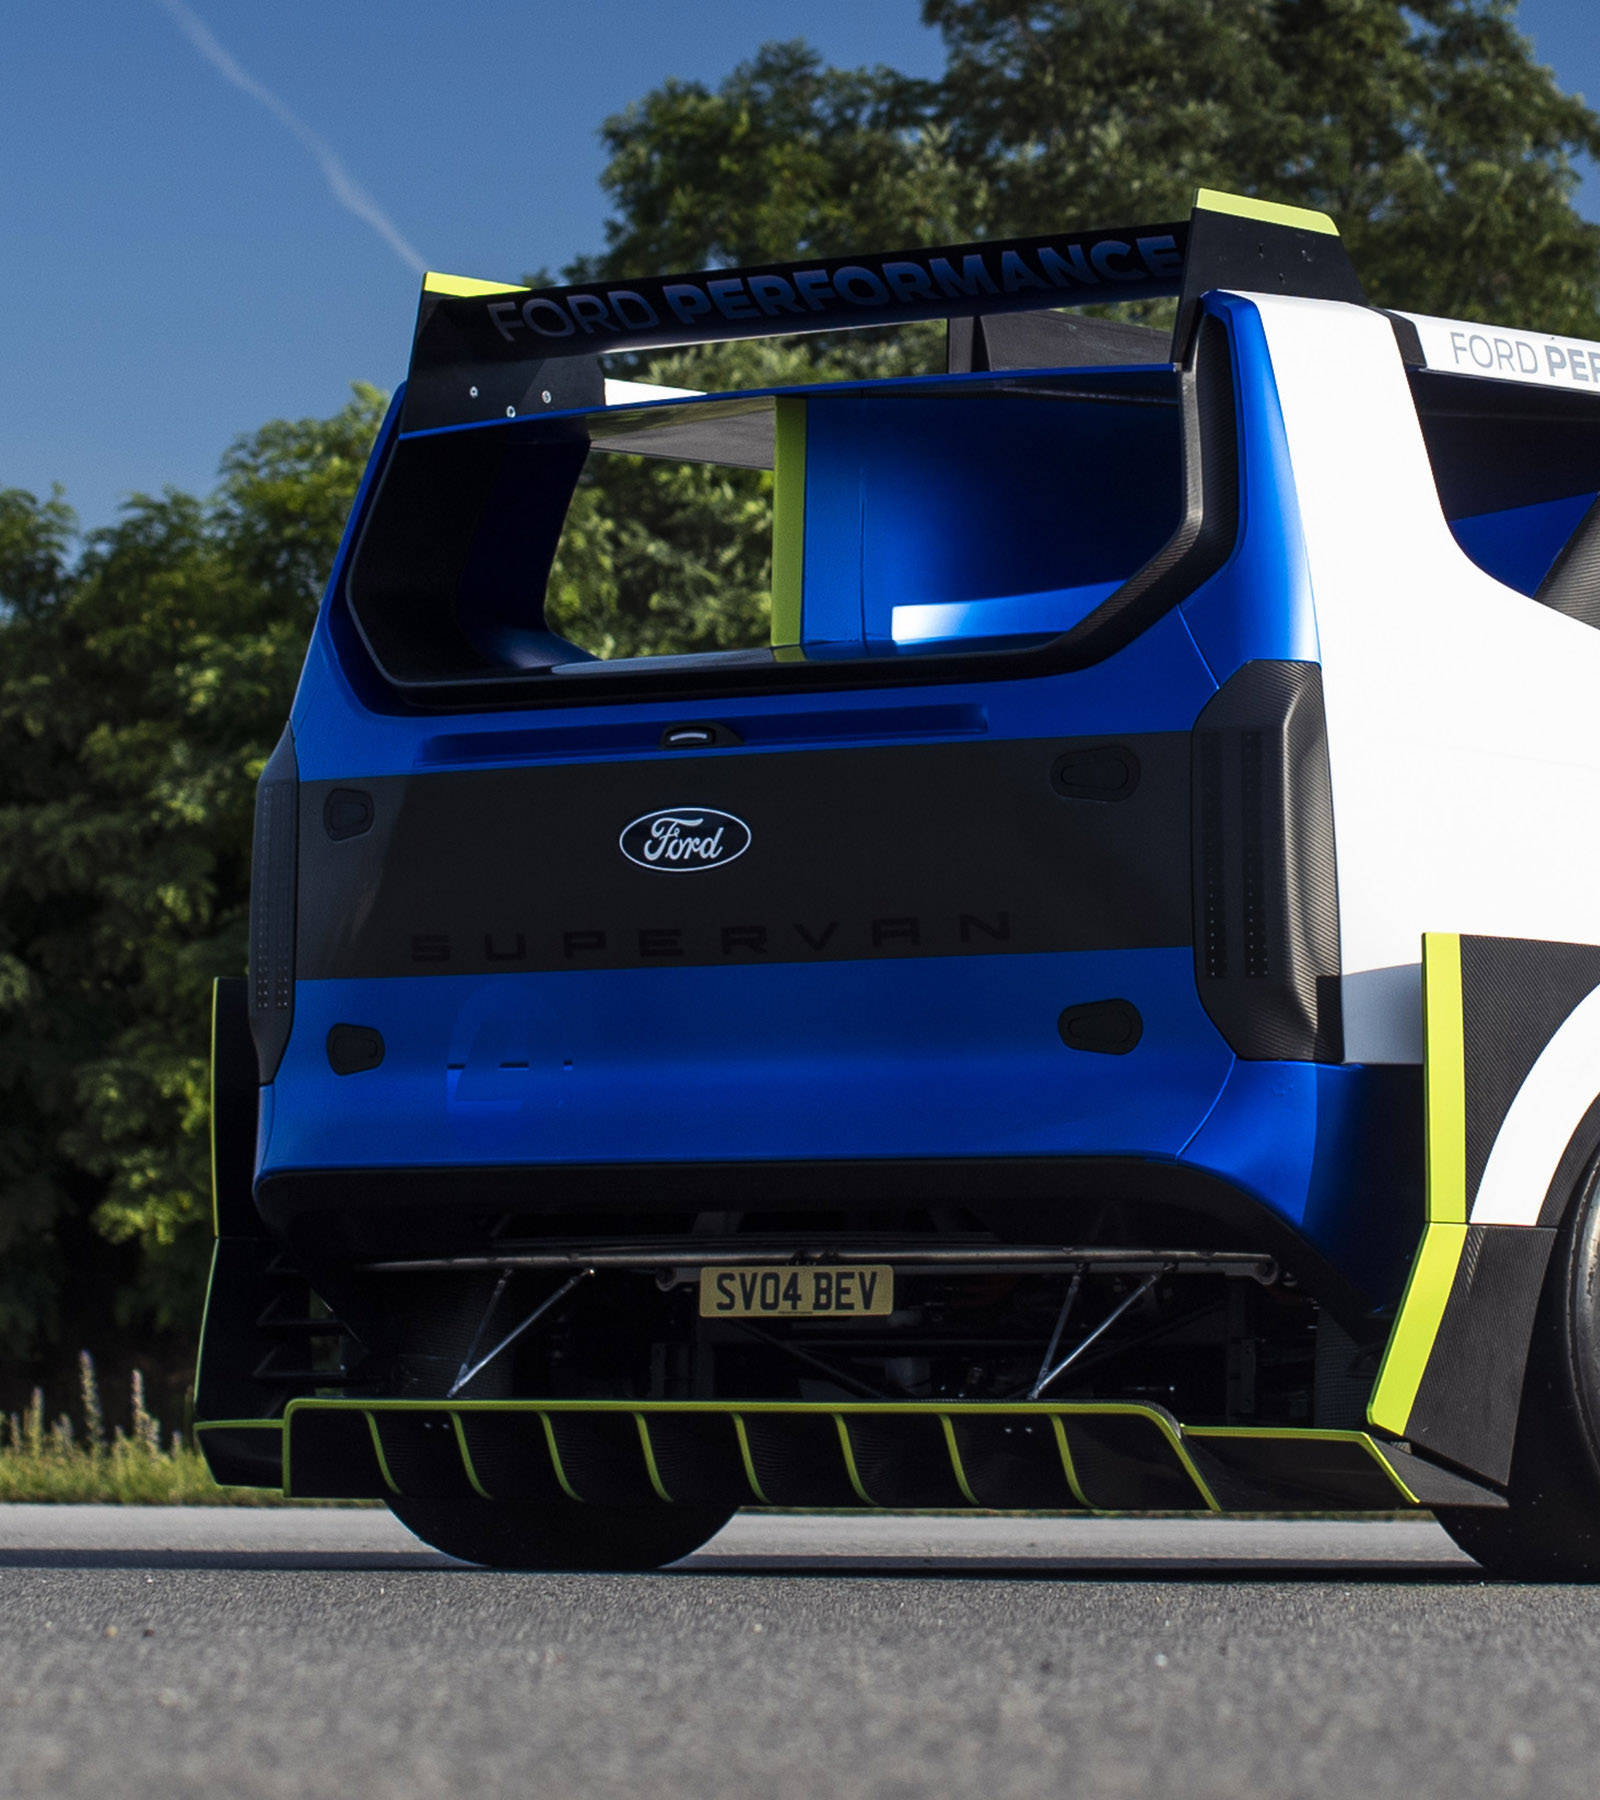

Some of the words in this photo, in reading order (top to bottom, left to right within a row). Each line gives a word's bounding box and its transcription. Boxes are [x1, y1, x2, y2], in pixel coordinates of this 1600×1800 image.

[486, 291, 659, 342] FORD
[662, 234, 1183, 325] PERFORMANCE
[1449, 331, 1538, 374] FORD
[644, 817, 725, 861] Ford
[410, 911, 1012, 963] SUPERVAN
[715, 1271, 802, 1311] SV04
[812, 1271, 878, 1311] BEV
